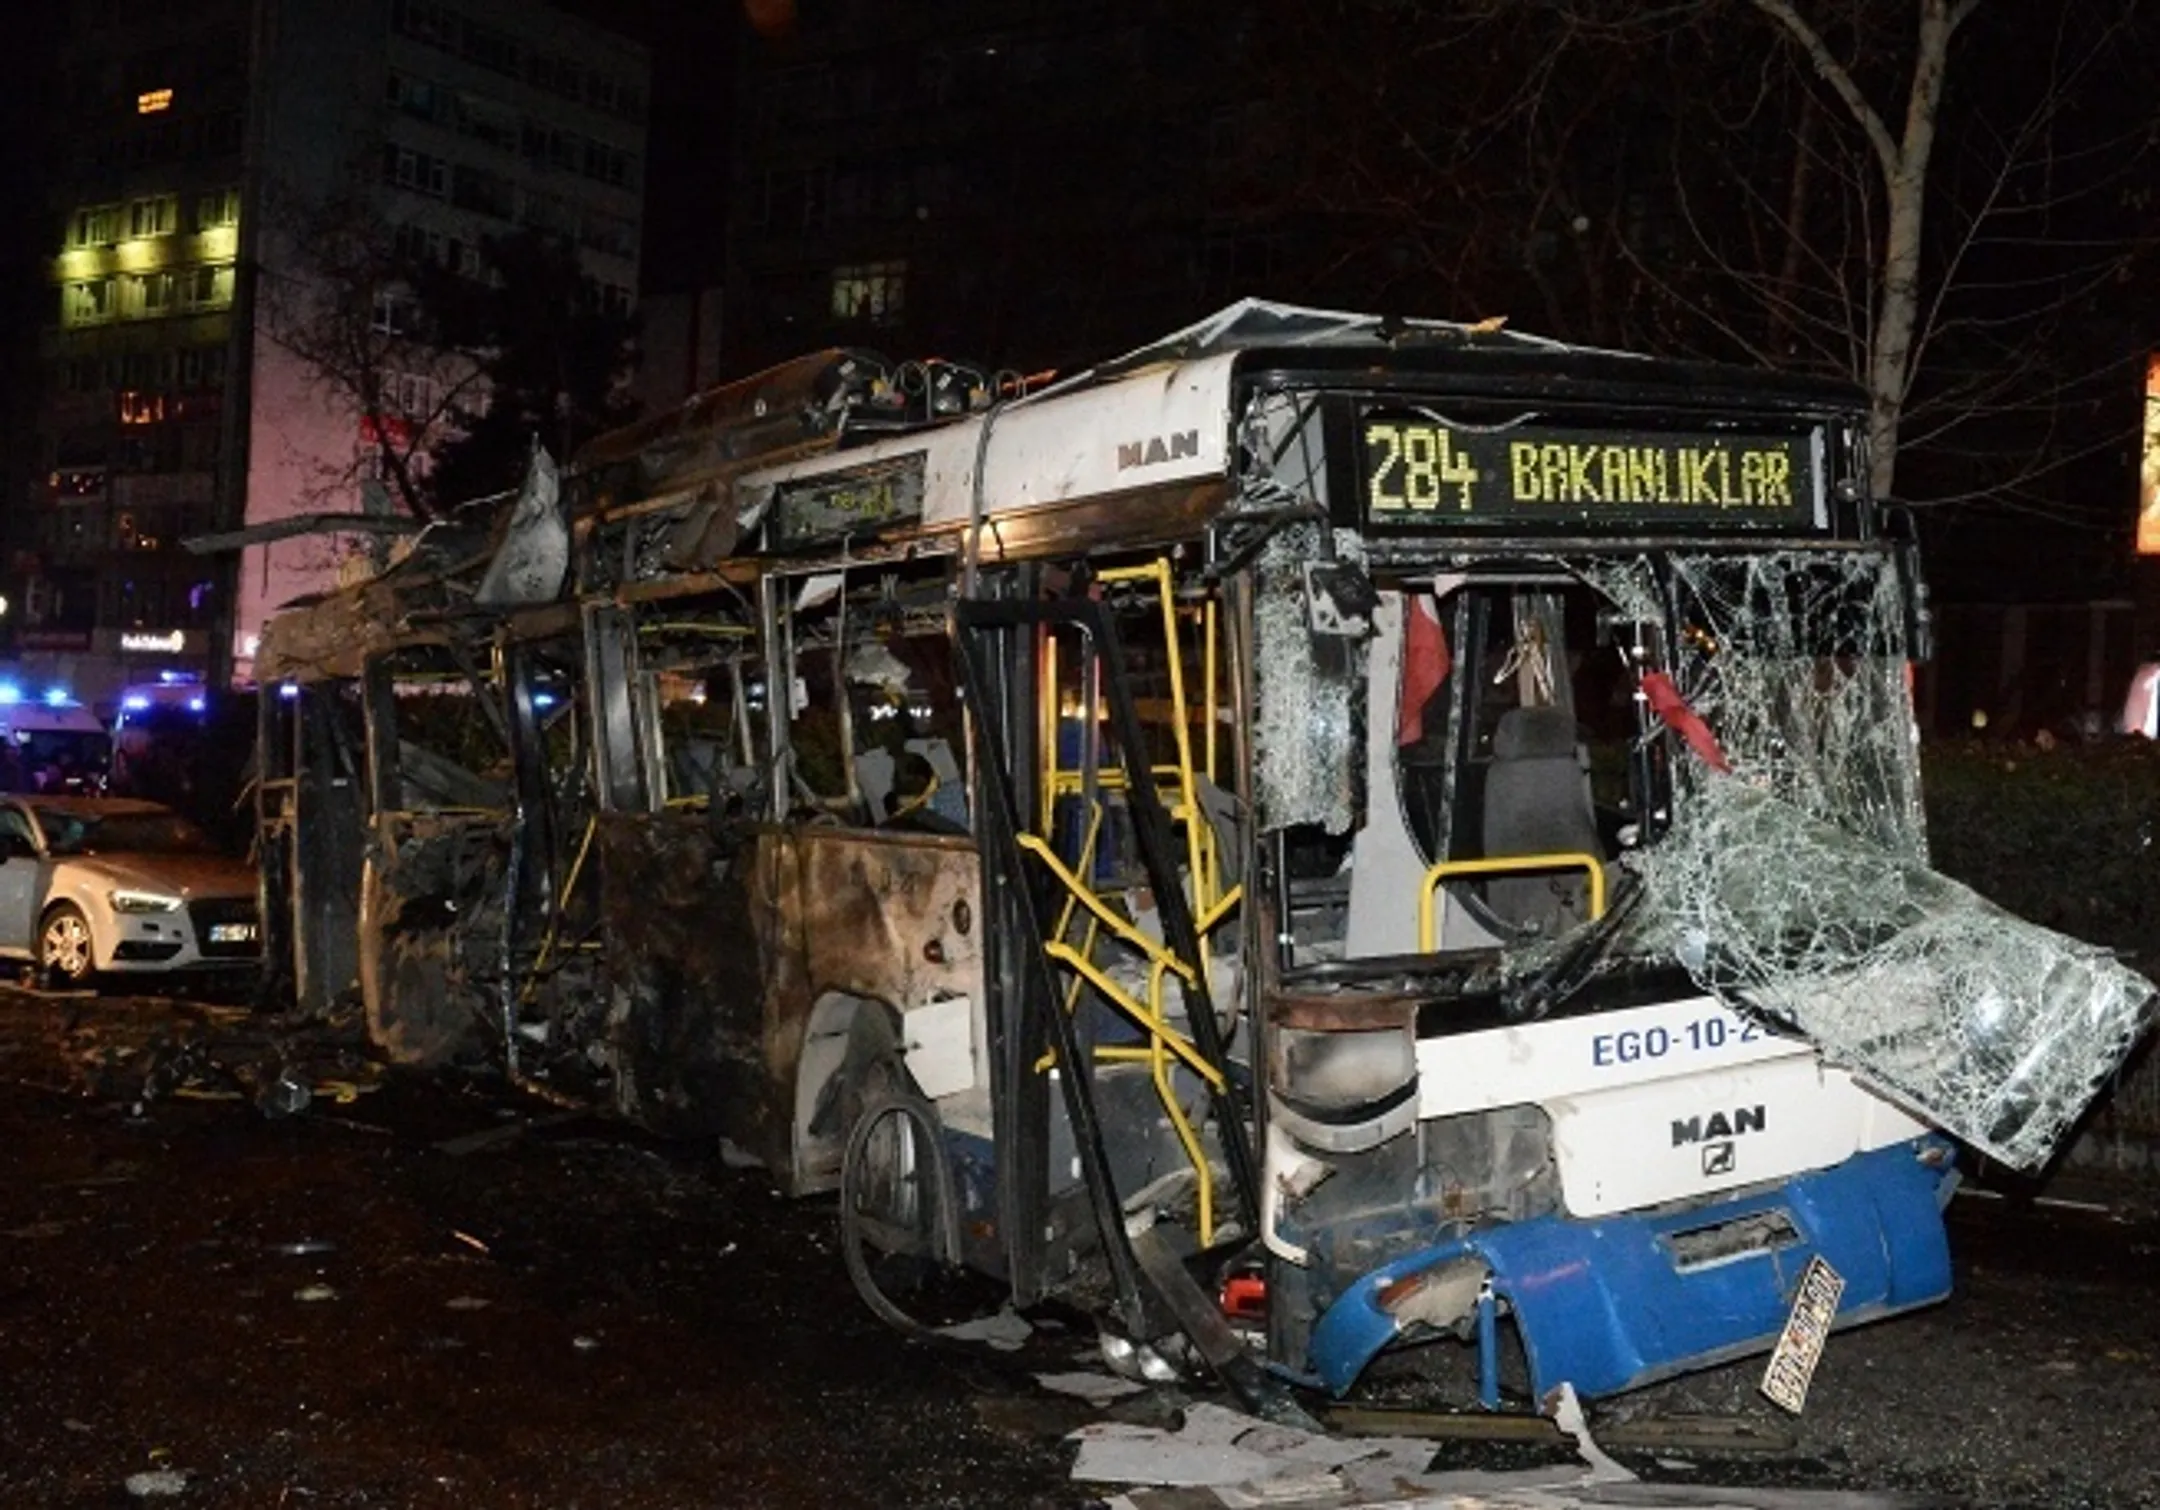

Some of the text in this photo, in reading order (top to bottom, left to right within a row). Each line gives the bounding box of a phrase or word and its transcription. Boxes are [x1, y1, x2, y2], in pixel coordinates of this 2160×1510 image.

[1118, 430, 1199, 471] MAN
[1366, 425, 1478, 511] 284
[1592, 1017, 1780, 1067] EGO-10-2
[1670, 1105, 1766, 1147] MAN
